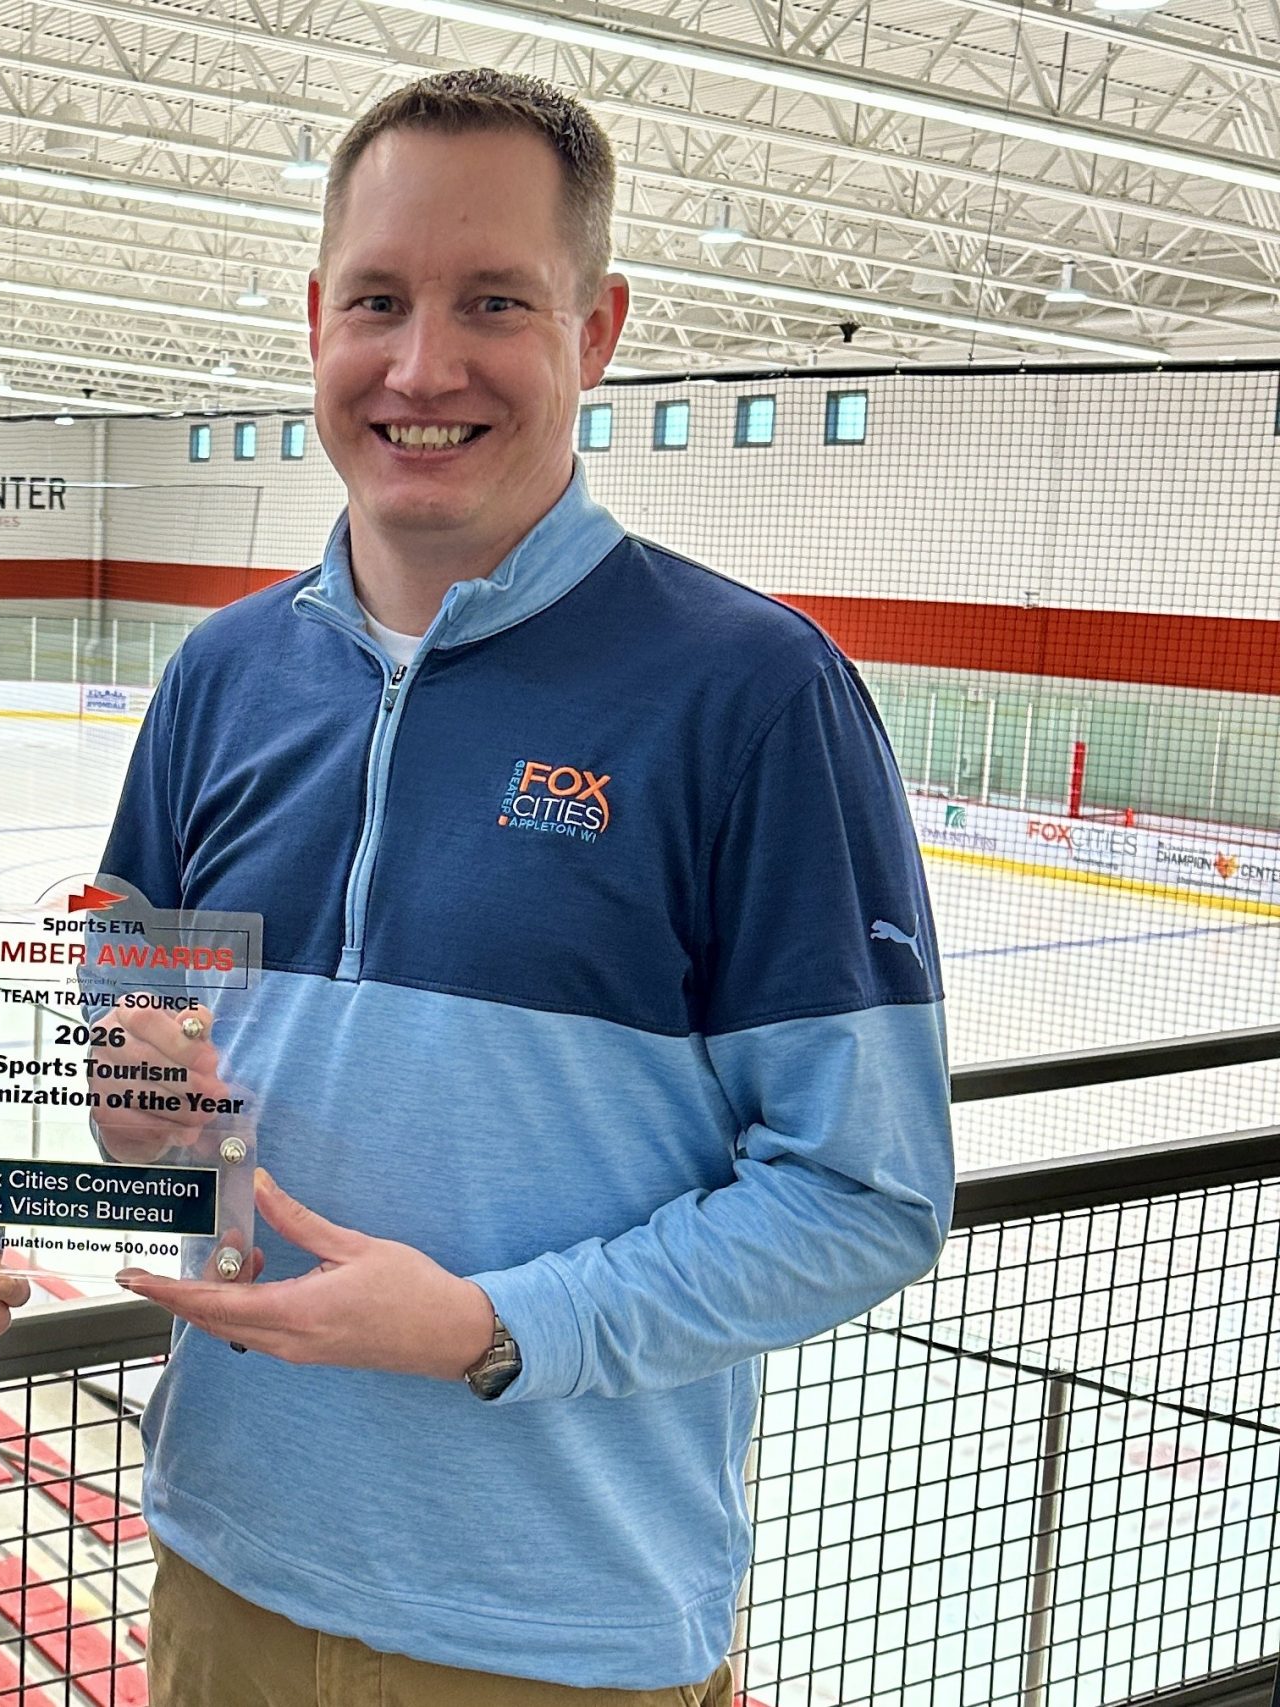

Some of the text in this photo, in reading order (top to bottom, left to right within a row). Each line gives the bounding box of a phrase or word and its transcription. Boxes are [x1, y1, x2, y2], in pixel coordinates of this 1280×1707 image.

[502, 760, 525, 813] GREATER
[520, 761, 611, 833] FOX
[513, 795, 603, 830] CITIES
[509, 817, 597, 844] APPLETON WI
[1028, 821, 1073, 856] FOX
[1157, 850, 1280, 882] CHAMPION CENTE
[96, 943, 235, 971] AWARDS
[1, 989, 199, 1011] TEAM TRAVEL SOURCE
[55, 1025, 126, 1048] 2026
[83, 1058, 188, 1082] Tourism
[106, 1089, 134, 1109] of
[137, 1090, 182, 1112] the
[185, 1092, 244, 1115] Year
[9, 1169, 69, 1191] Cities
[75, 1173, 199, 1199] Convention
[10, 1196, 89, 1219] Visitors
[97, 1201, 173, 1223] Bureau
[67, 1239, 111, 1253] below
[115, 1241, 179, 1257] 500,000
